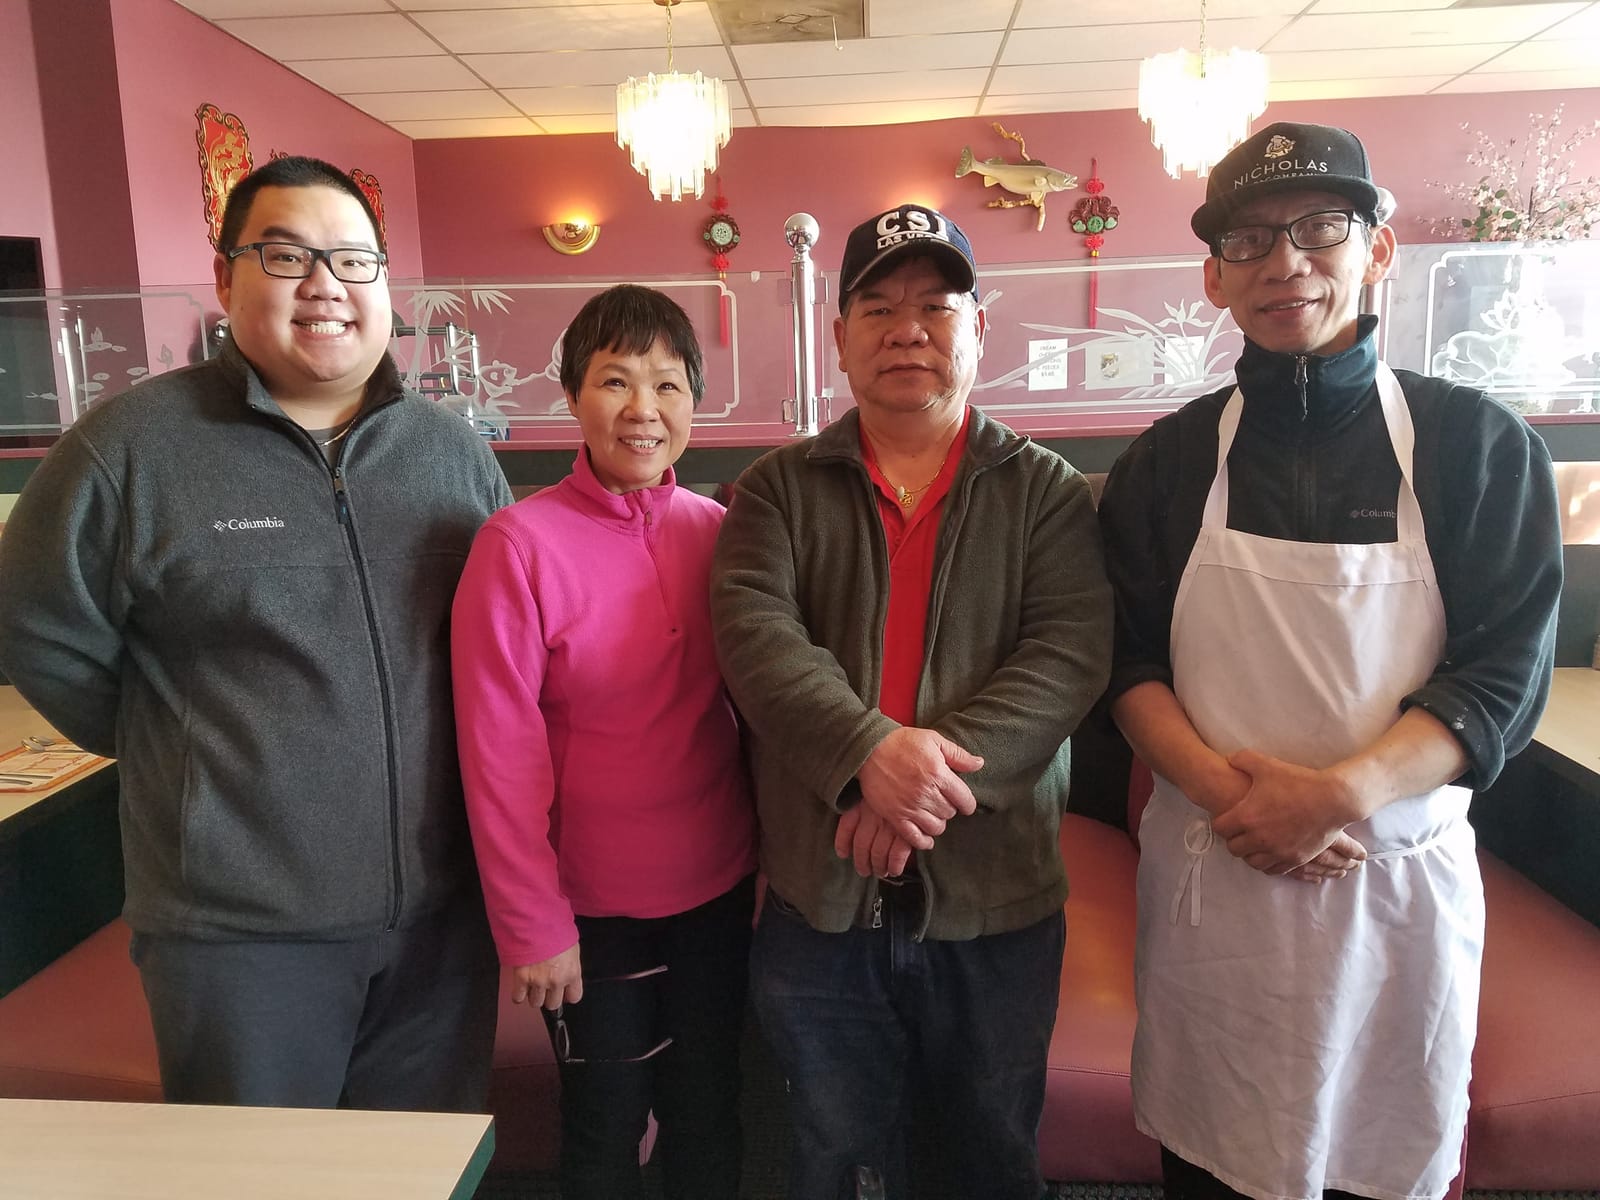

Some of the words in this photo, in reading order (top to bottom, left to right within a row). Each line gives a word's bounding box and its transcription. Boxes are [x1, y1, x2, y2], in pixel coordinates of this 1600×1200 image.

[1234, 159, 1328, 190] NICHOLAS
[877, 211, 951, 243] CSI
[877, 235, 903, 250] LAS
[228, 516, 286, 530] Columbia
